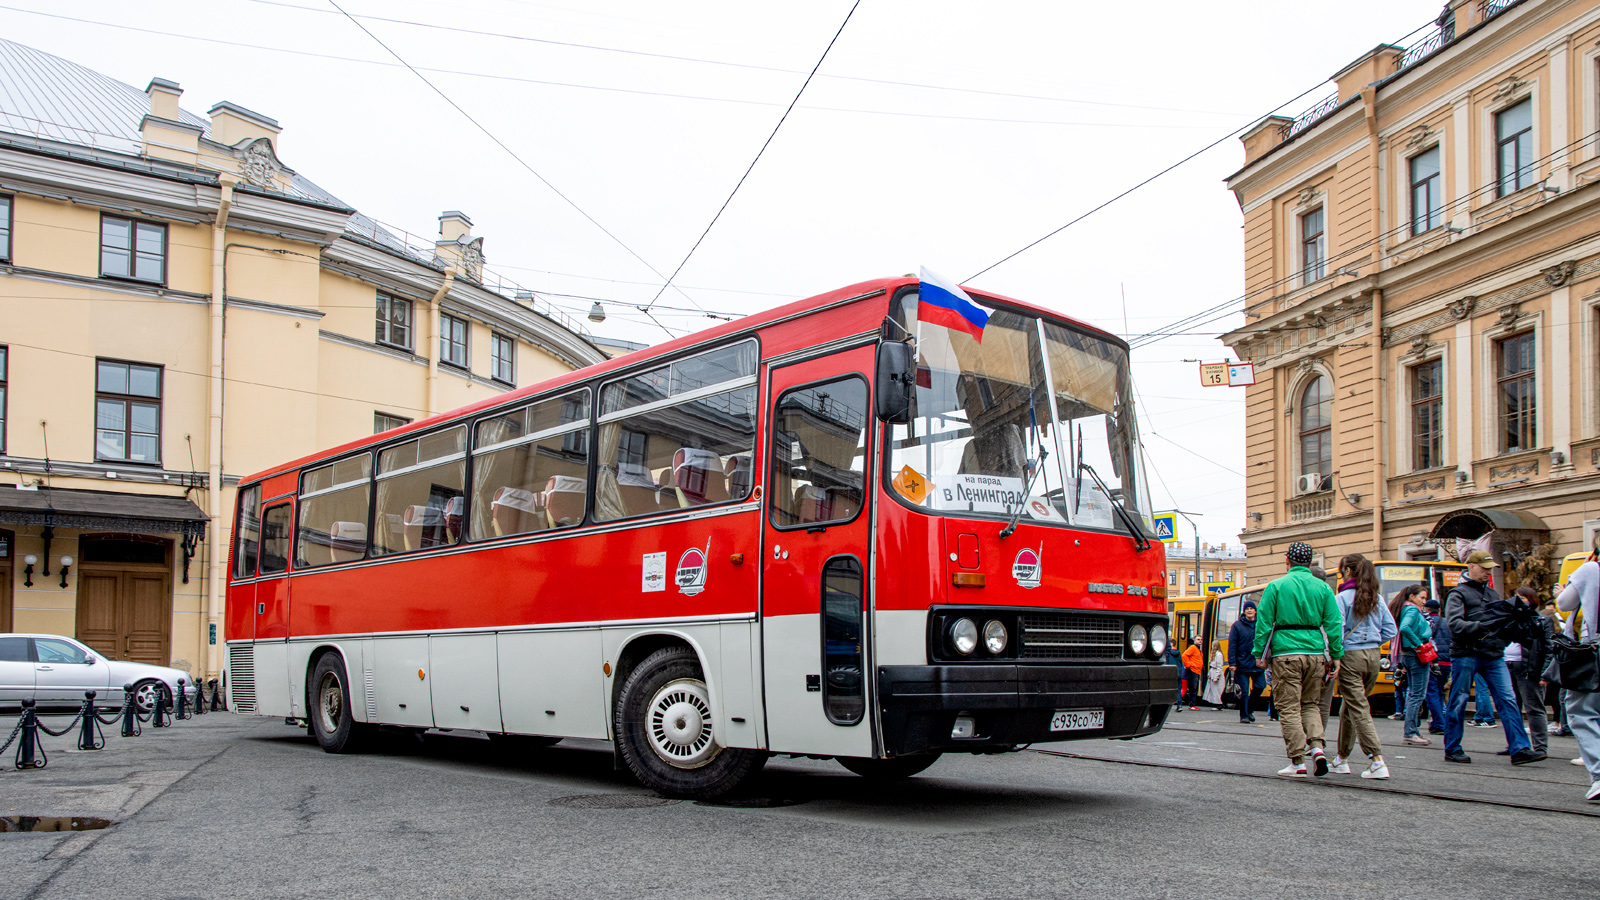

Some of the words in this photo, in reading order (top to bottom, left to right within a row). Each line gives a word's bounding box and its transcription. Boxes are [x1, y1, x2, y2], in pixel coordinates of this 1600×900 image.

[1210, 374, 1221, 383] 15
[978, 477, 1002, 486] парад
[957, 483, 1024, 508] Ленинград
[1088, 583, 1124, 594] IKARUS
[1127, 585, 1148, 597] 256
